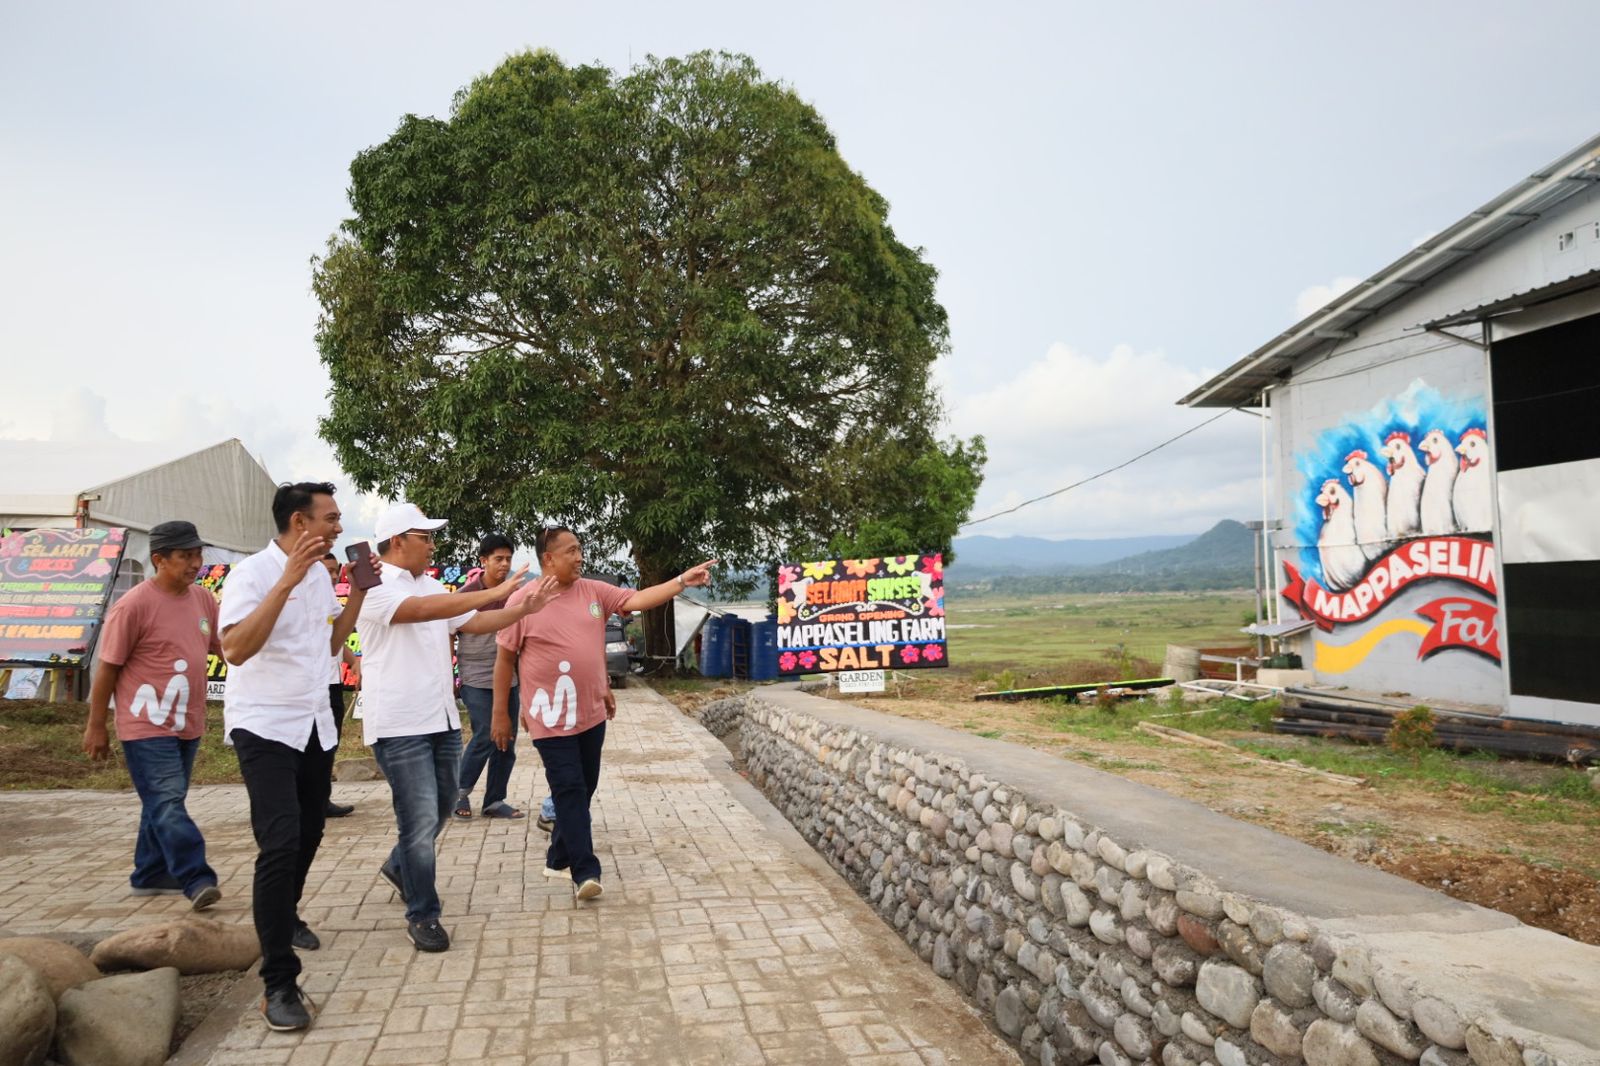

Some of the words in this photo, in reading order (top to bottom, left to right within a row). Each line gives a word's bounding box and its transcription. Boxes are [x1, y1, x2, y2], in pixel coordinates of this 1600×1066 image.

[20, 543, 99, 557] SELAMAT
[1313, 541, 1498, 620] MAPPASELIN
[819, 612, 855, 623] GRAND
[859, 610, 906, 621] OPENING
[777, 620, 899, 649] MAPPASELING
[901, 617, 945, 642] FARM
[819, 645, 895, 670] SALT
[840, 672, 883, 683] GARDEN
